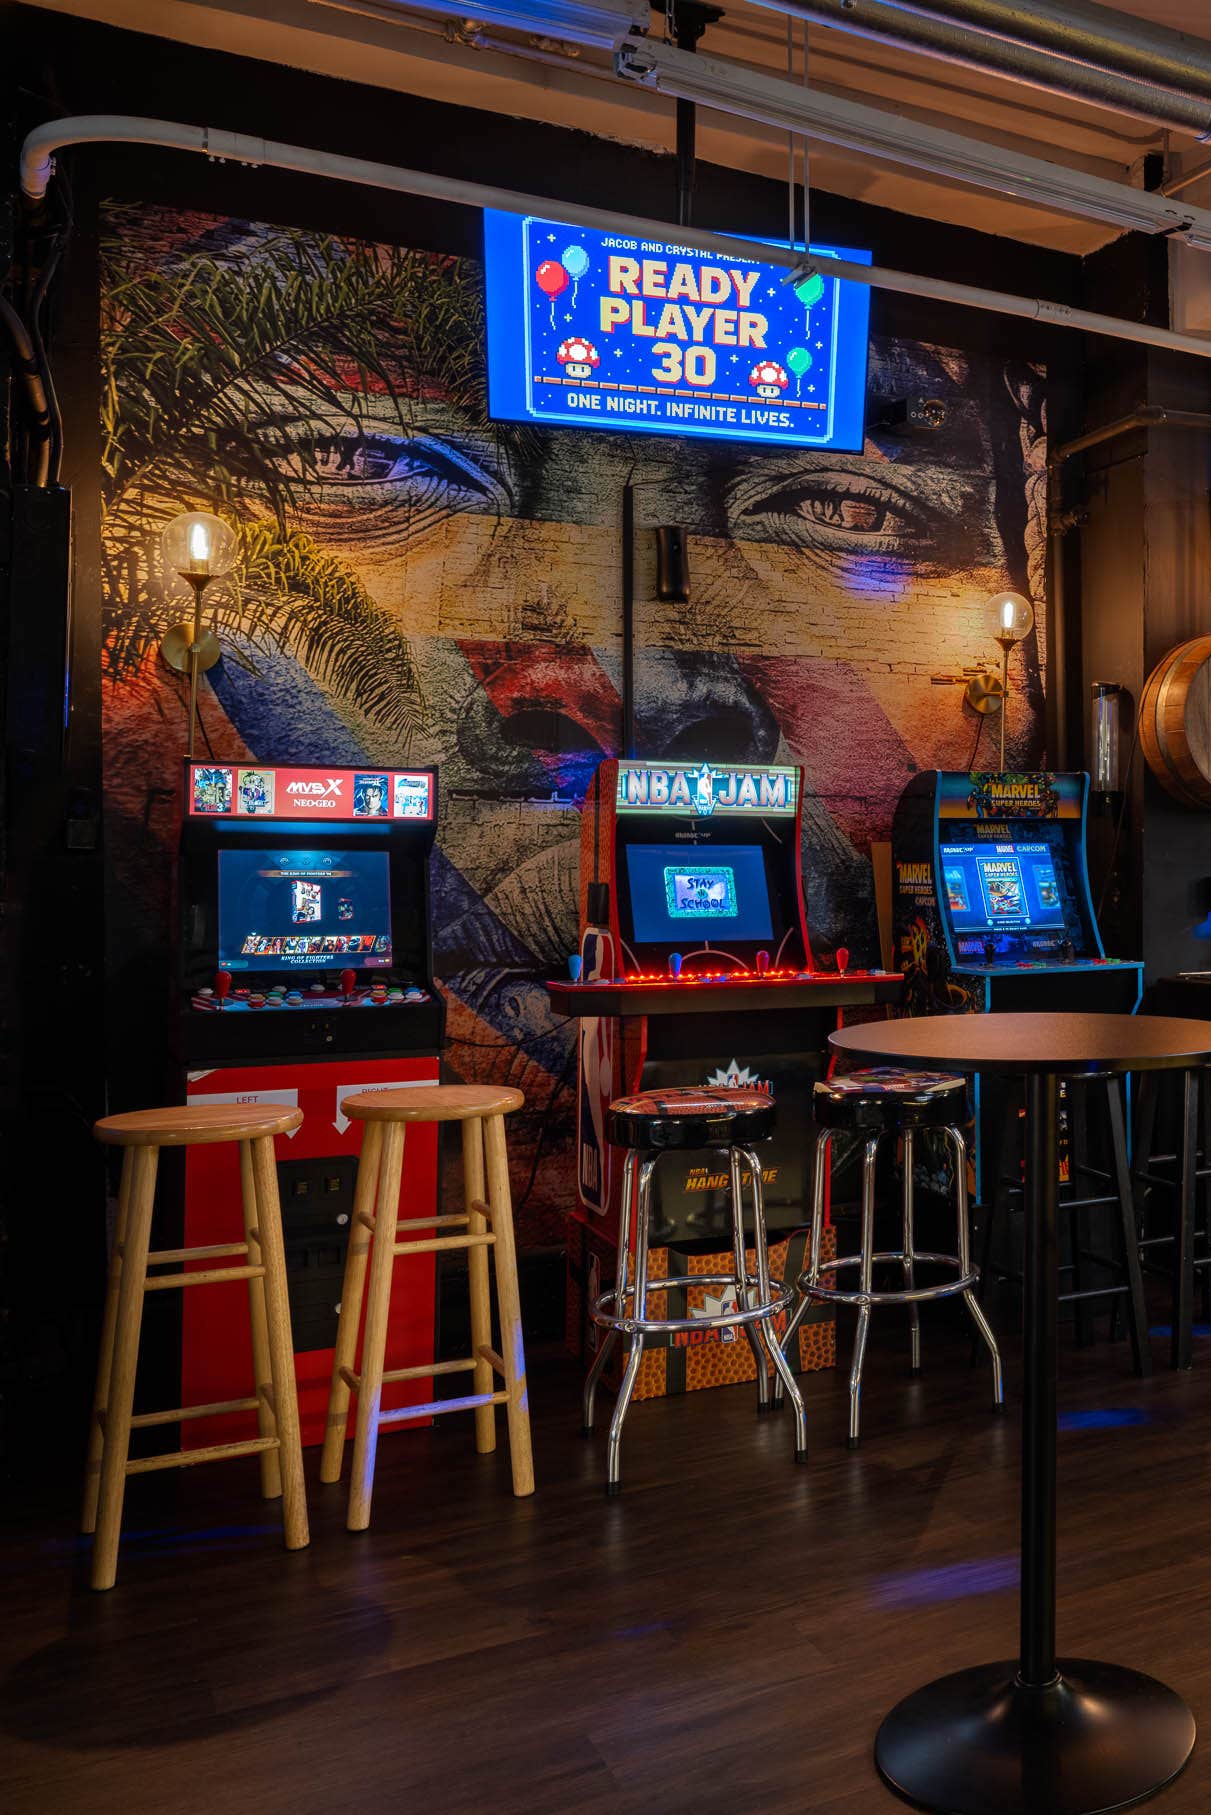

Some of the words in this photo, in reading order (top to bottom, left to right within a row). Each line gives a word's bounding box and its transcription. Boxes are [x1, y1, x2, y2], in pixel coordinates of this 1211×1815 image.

[601, 238, 638, 250] JACOB
[641, 242, 663, 253] AND
[608, 255, 761, 308] READY
[600, 297, 769, 349] PLAYER
[651, 342, 717, 387] 30
[567, 392, 601, 411] ONE
[606, 397, 661, 416] NIGHT.
[666, 401, 737, 424] INFINITE
[741, 407, 795, 428] LIVES.
[627, 768, 691, 806] NBA
[718, 772, 787, 808] JAM
[991, 783, 1041, 799] MARVEL
[976, 823, 1011, 834] MARVEL
[899, 863, 933, 884] MARVEL
[983, 862, 1017, 873] MARVEL
[687, 877, 714, 890] STAY
[680, 898, 725, 909] SCHOOL
[236, 1095, 258, 1104] LEFT
[685, 1173, 729, 1191] HANG
